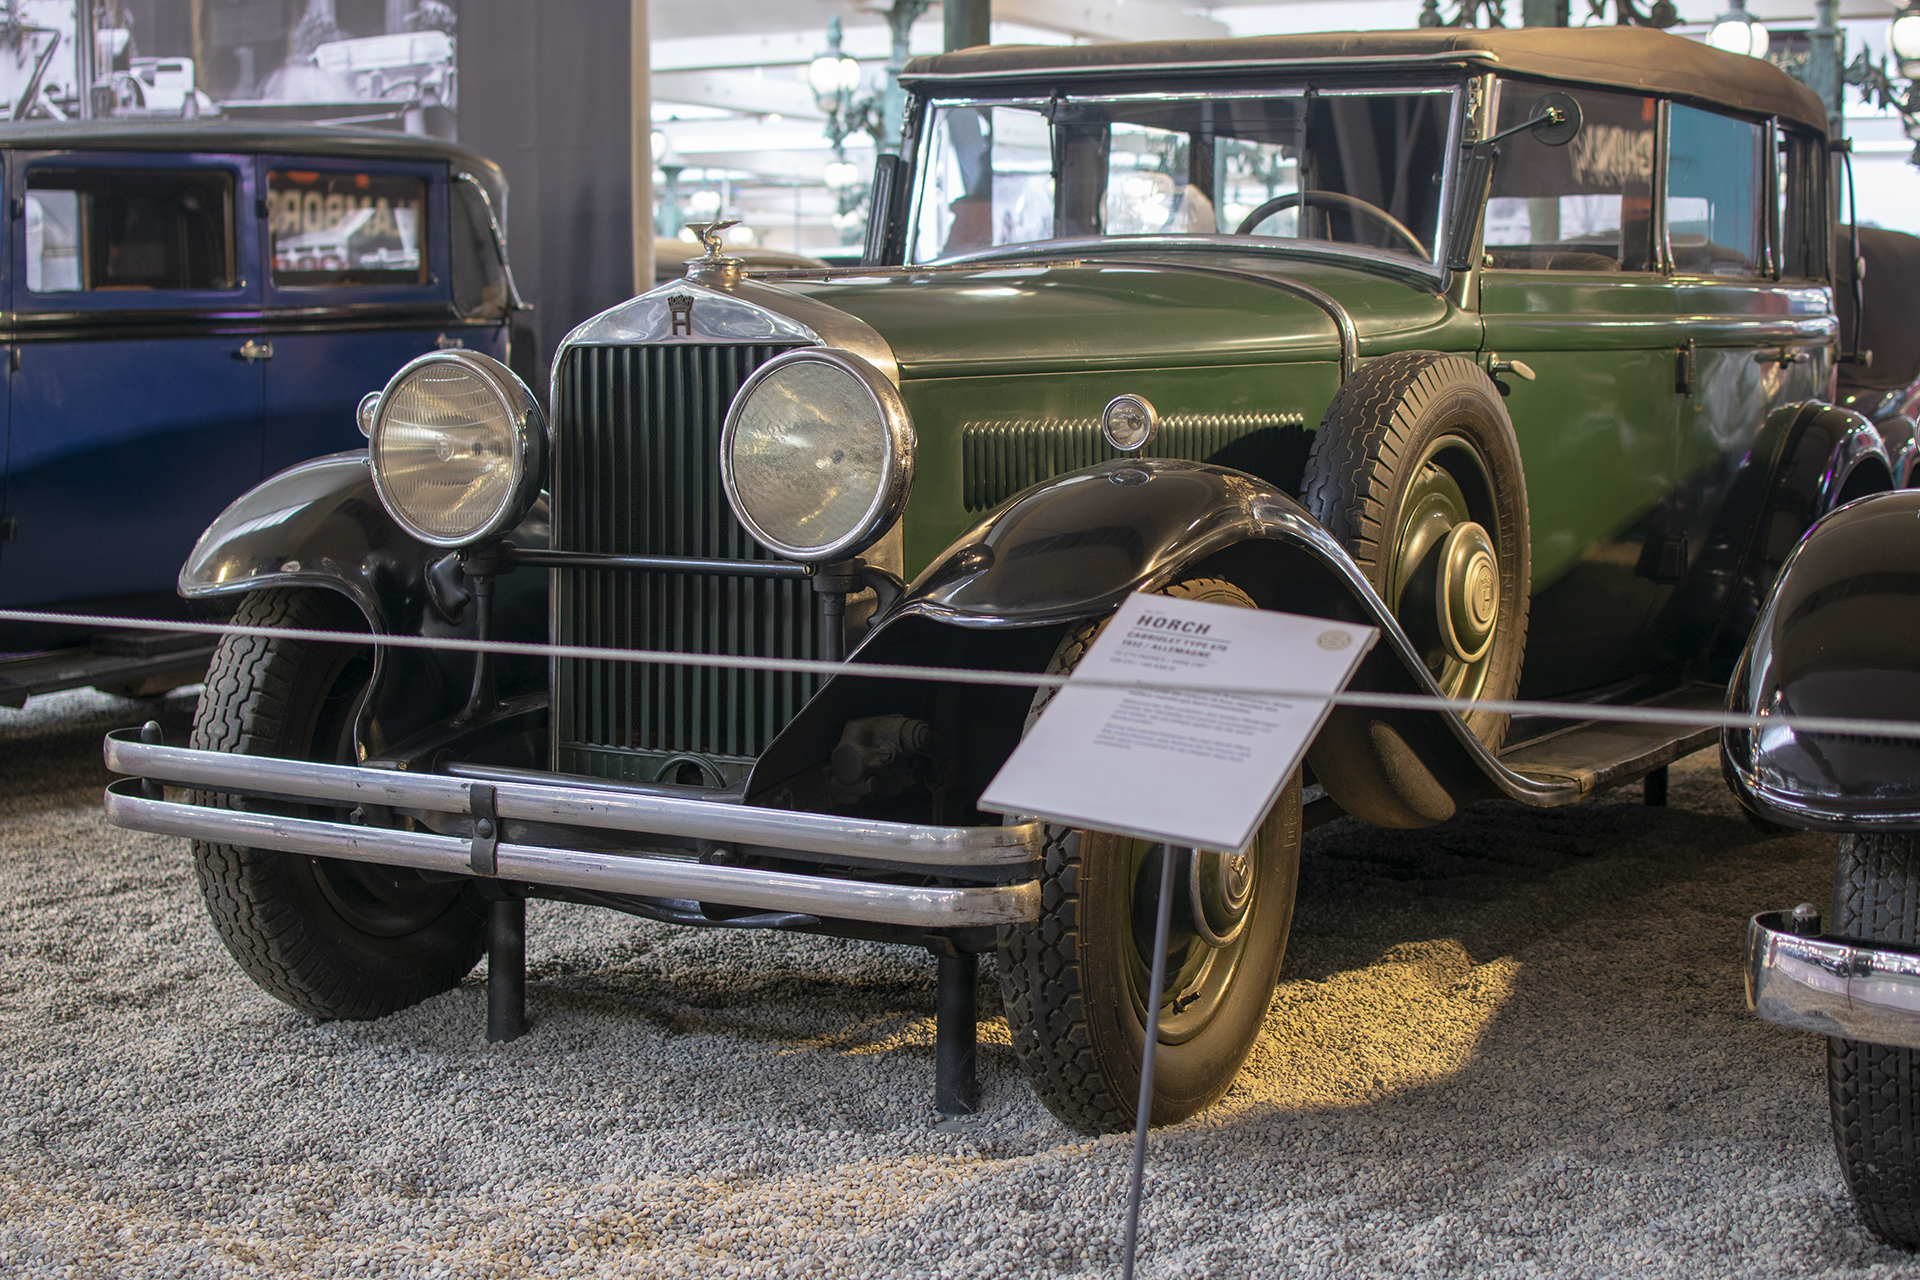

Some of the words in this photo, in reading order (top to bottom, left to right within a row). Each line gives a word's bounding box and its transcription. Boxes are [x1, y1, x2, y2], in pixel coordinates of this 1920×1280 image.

[672, 308, 691, 335] H
[1136, 614, 1211, 635] HORCH
[1127, 630, 1181, 645] CABRIOLET
[1183, 638, 1209, 649] TYPE
[1150, 643, 1211, 658] ALLEMAGNE
